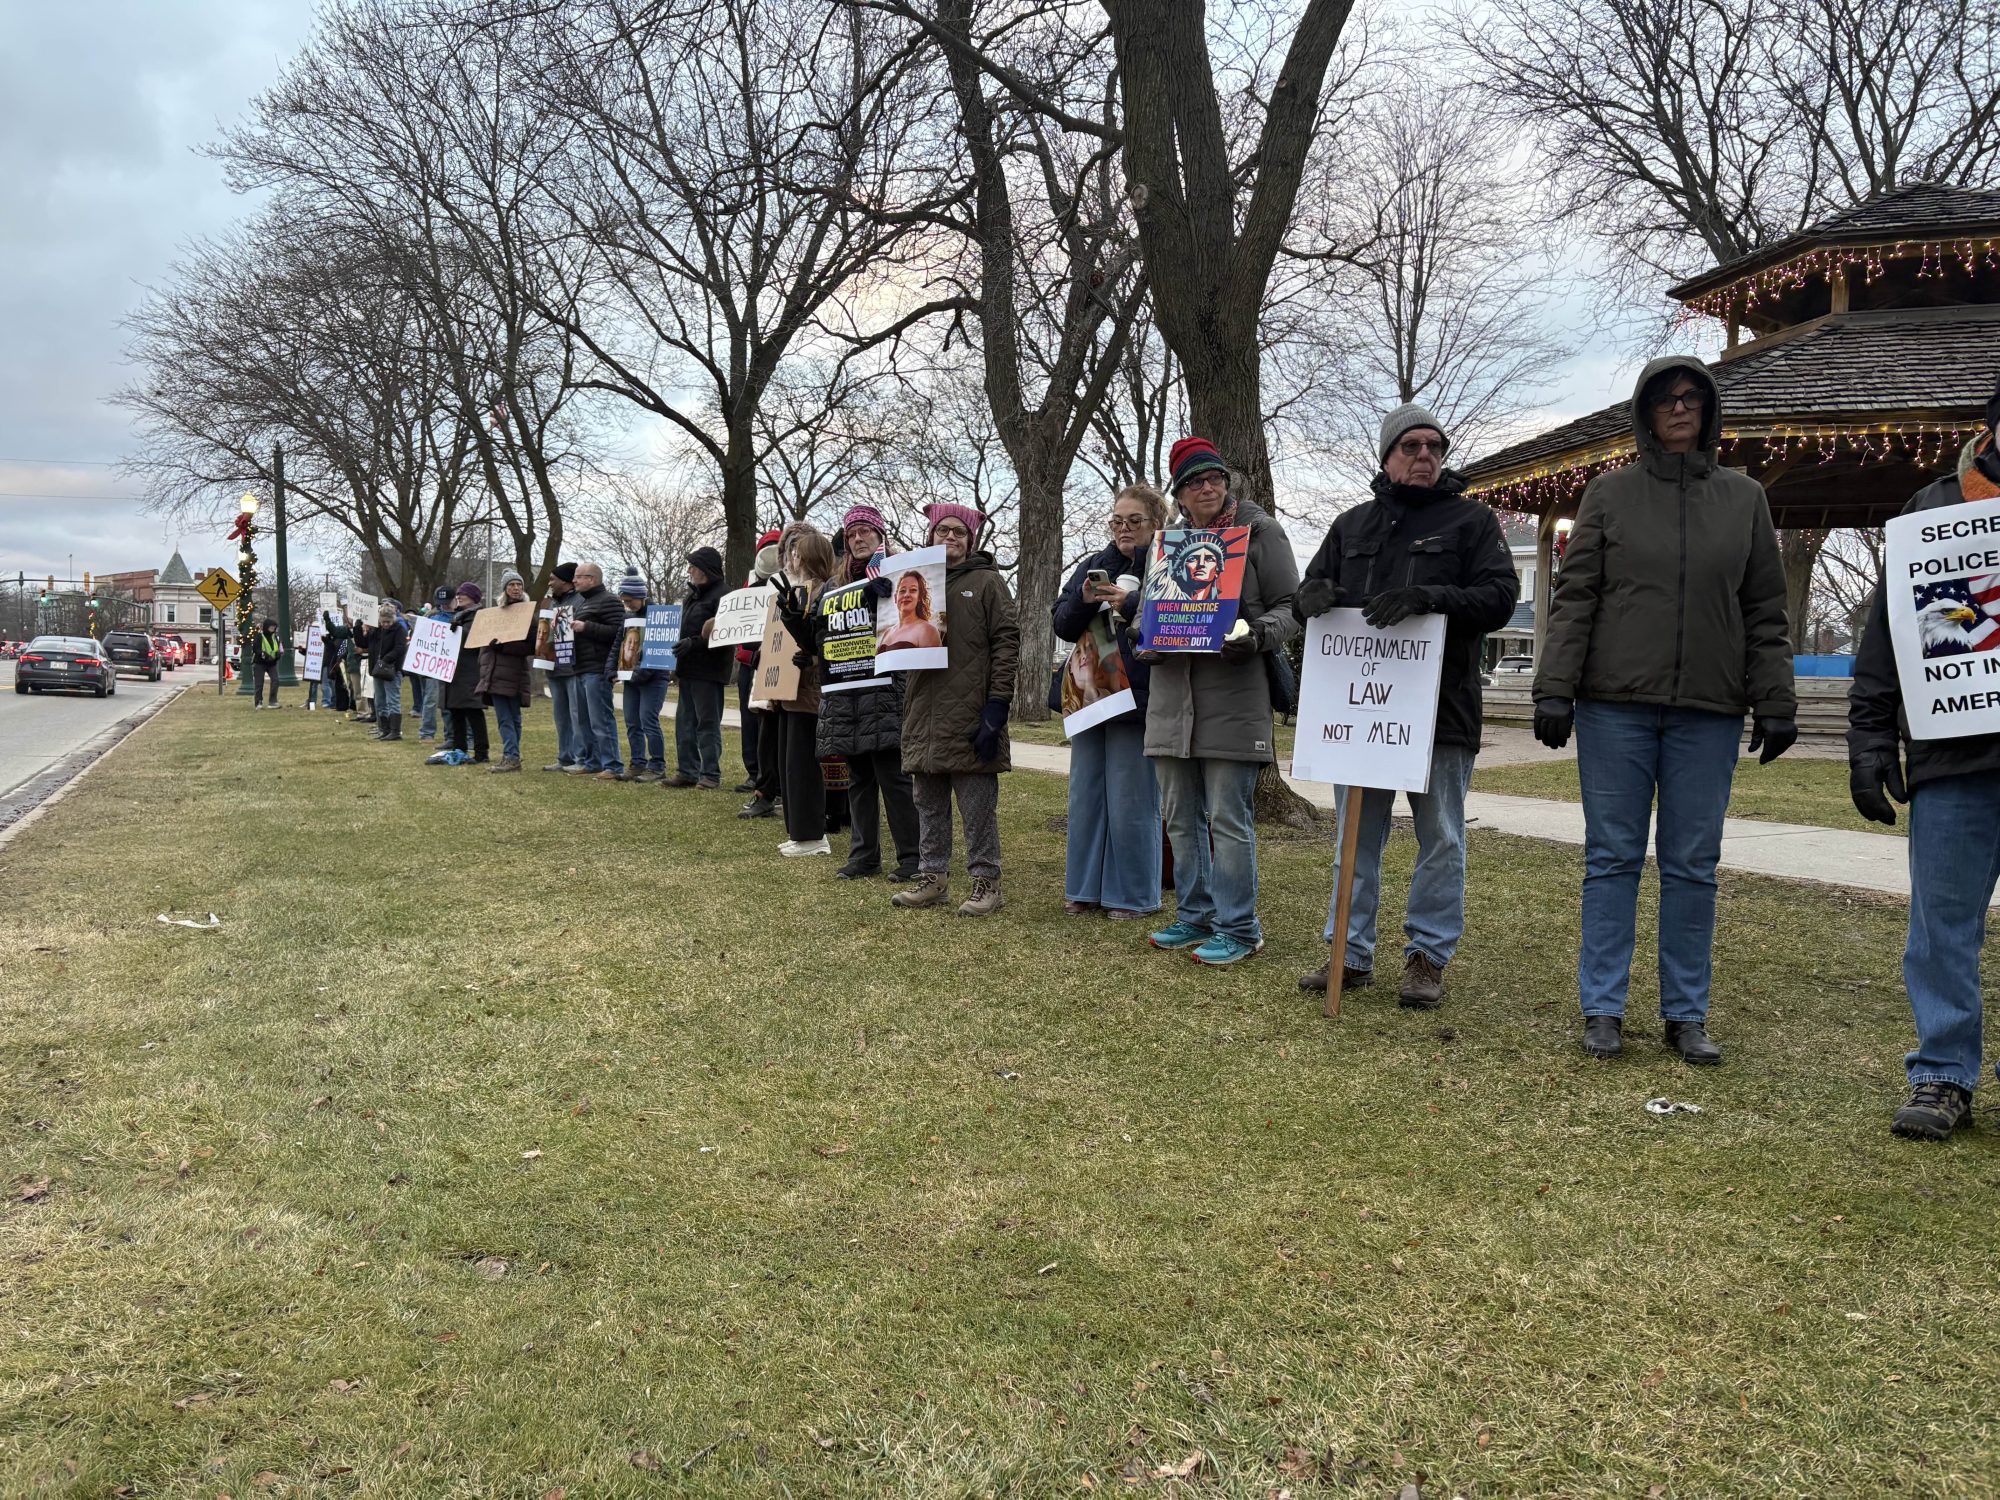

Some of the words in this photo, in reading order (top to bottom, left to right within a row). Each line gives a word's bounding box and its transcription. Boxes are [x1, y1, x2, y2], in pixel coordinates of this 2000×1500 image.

[1921, 515, 2000, 543] SECRE
[1909, 550, 1999, 579] POLICE
[823, 595, 839, 616] ICE
[842, 589, 863, 611] OUT
[1156, 602, 1180, 612] WHEN
[1180, 602, 1219, 612] INJUSTICE
[1157, 613, 1195, 624] BECOMES
[1196, 614, 1214, 624] LAW
[430, 622, 447, 639] ICE
[644, 627, 680, 642] NEIGHBOR
[1160, 625, 1208, 635] RESISTANCE
[416, 638, 438, 653] must
[441, 641, 450, 656] be
[831, 639, 871, 648] NATIONWIDE
[1152, 636, 1190, 646] BECOMES
[1190, 636, 1212, 647] DUTY
[1321, 633, 1431, 661] GOVERNMENT
[826, 647, 850, 655] WEEKEND
[1361, 661, 1381, 677] OF
[1924, 660, 1975, 683] NOT
[1348, 681, 1393, 705] LAW
[1931, 690, 2000, 715] AMER
[1323, 723, 1353, 741] NOT
[1366, 720, 1411, 746] MEN
